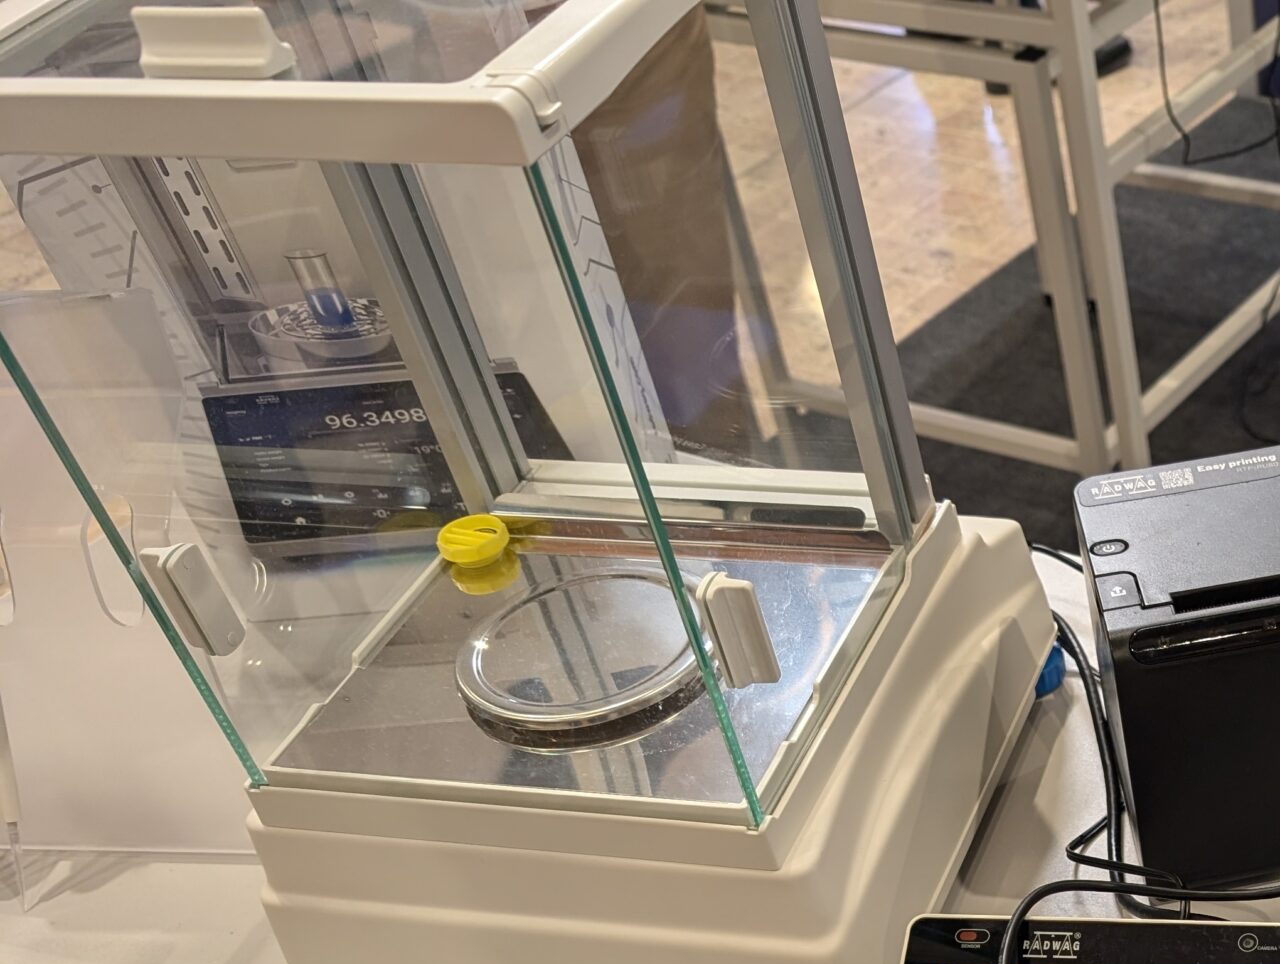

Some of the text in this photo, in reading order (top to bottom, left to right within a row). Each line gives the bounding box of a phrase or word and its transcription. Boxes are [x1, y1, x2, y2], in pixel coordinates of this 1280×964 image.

[325, 408, 427, 429] 96.3498
[1197, 454, 1277, 473] Easy printing
[1091, 478, 1156, 496] RADWAG
